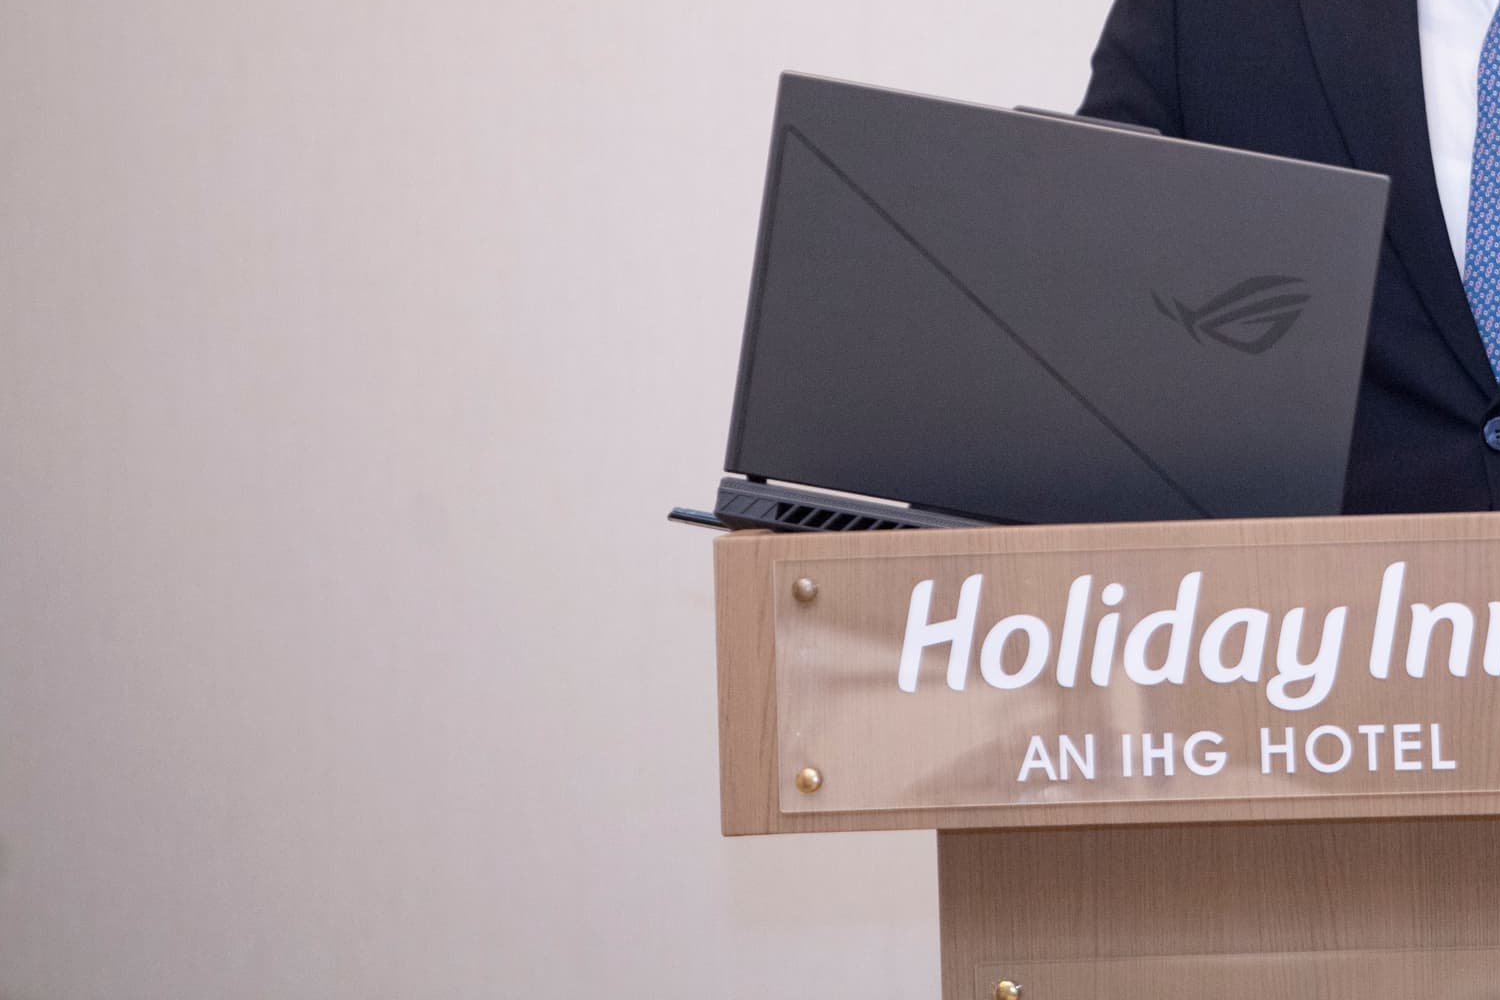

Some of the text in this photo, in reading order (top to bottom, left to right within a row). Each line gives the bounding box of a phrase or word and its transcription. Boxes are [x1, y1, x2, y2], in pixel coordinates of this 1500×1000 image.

[898, 571, 1346, 711] Holiday
[1017, 722, 1457, 782] AN IHG HOTEL
